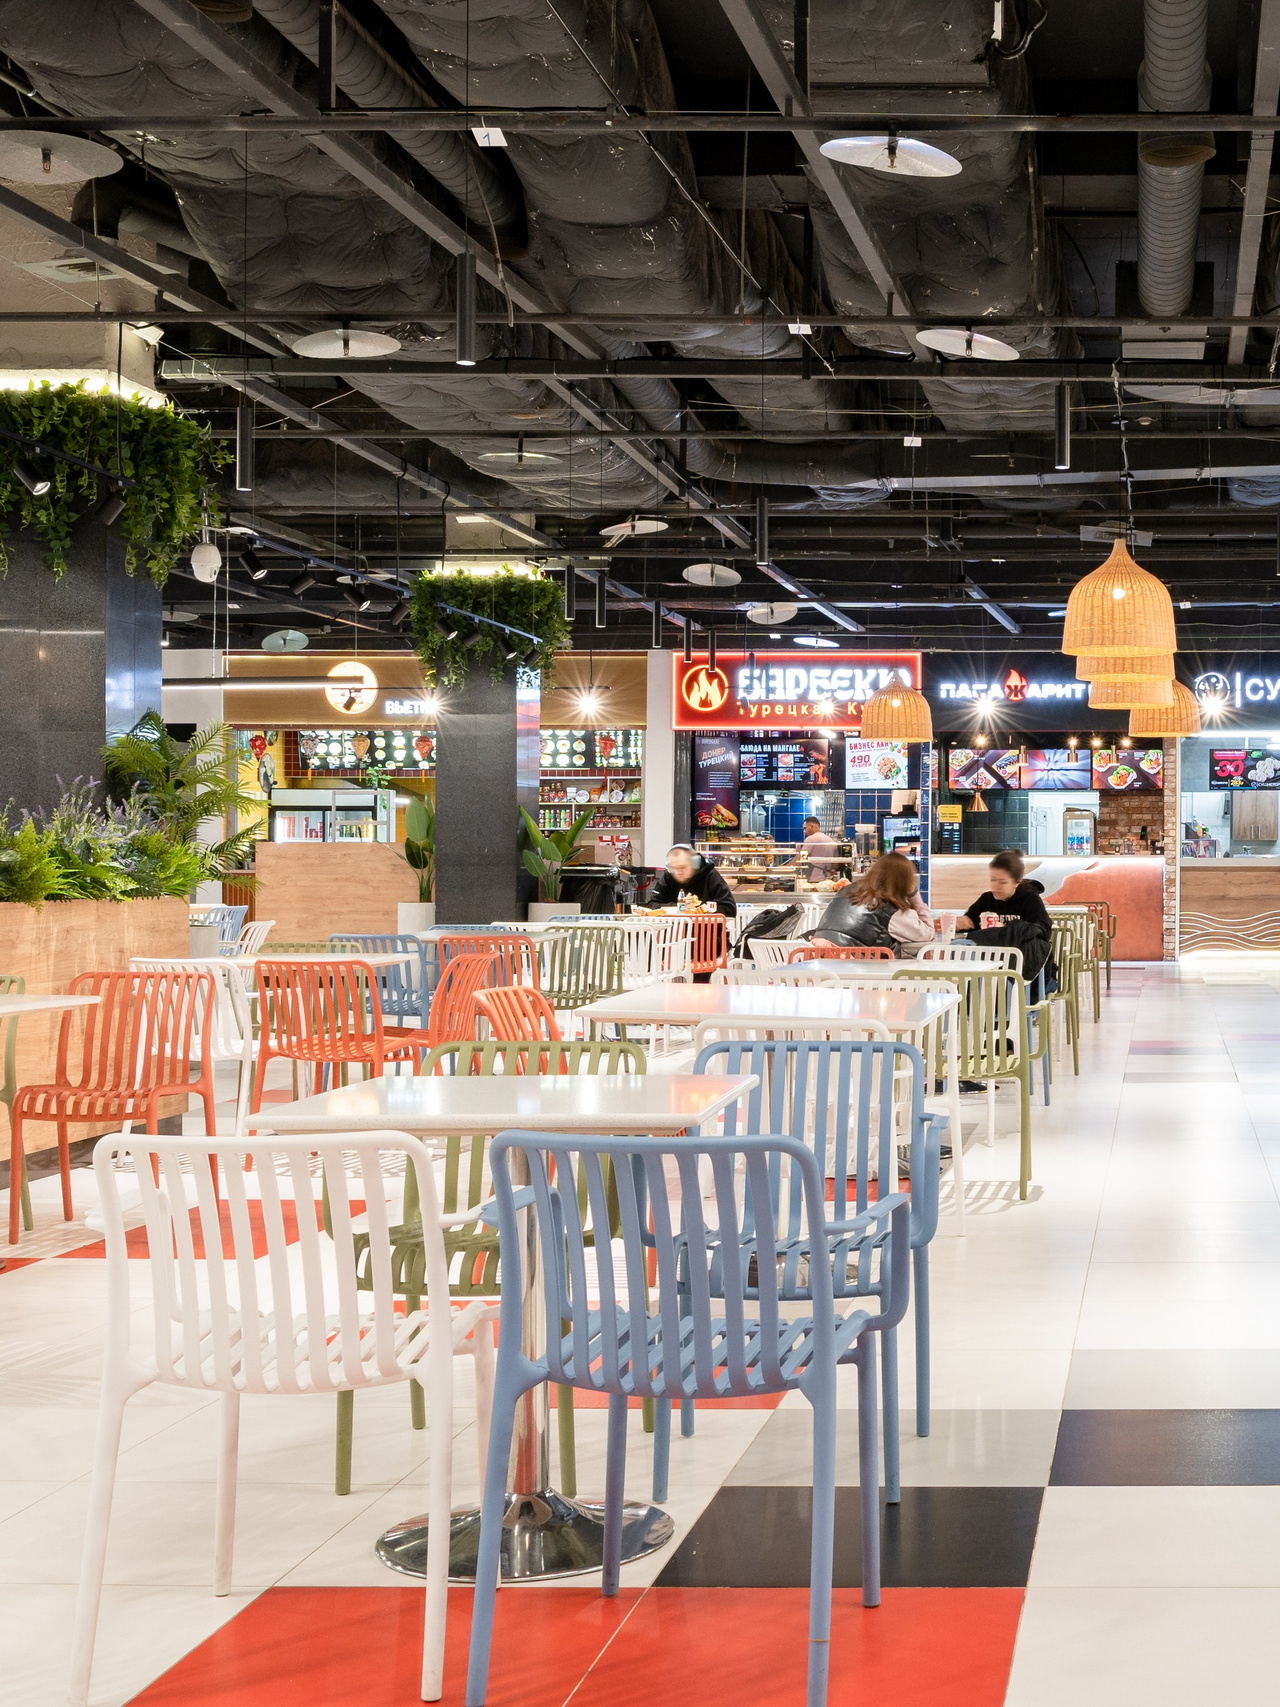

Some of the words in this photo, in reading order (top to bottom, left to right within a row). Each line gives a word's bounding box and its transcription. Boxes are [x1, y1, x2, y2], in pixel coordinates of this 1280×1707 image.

[736, 702, 833, 717] урецка
[740, 744, 762, 753] БЛЮДА
[763, 744, 772, 753] НА
[772, 744, 801, 753] МАНГАЛЕ
[849, 741, 875, 751] БИЗНЕС
[698, 750, 734, 768] ТУРЕЦКИЙ
[701, 747, 726, 760] ДОНЕР
[850, 754, 871, 765] 490
